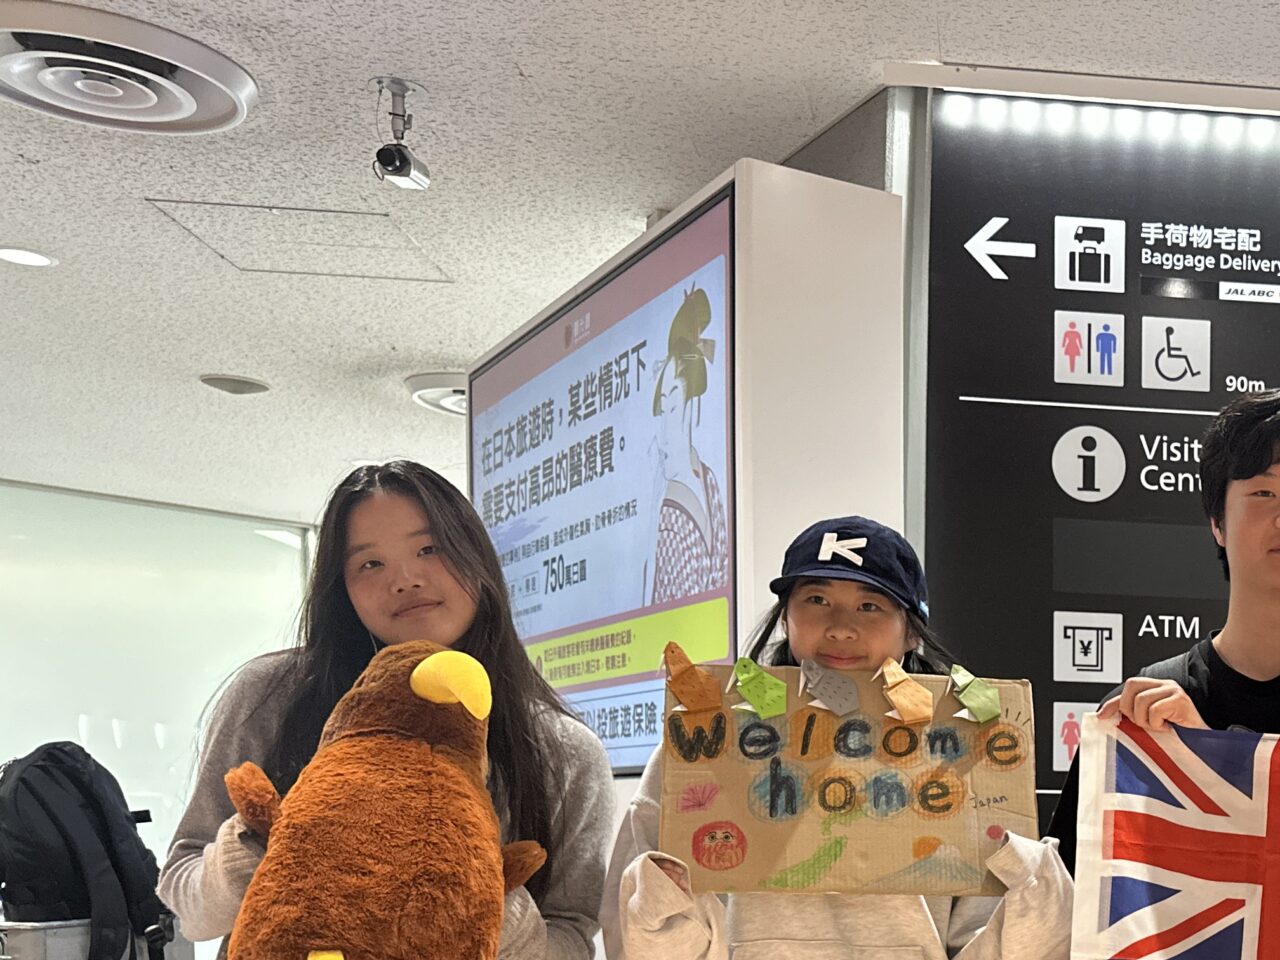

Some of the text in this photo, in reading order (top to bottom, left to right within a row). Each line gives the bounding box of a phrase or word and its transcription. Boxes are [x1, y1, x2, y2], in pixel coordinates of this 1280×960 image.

[1141, 222, 1261, 251] 手荷物宅配
[1141, 249, 1215, 271] Baggage
[1225, 288, 1275, 298] JAL ABC
[1225, 375, 1266, 392] 90m
[1139, 434, 1203, 463] Visit
[818, 533, 868, 566] K
[1138, 615, 1200, 639] ATM
[667, 711, 1021, 767] Welcome
[768, 756, 956, 819] home
[969, 791, 1008, 810] Japan
